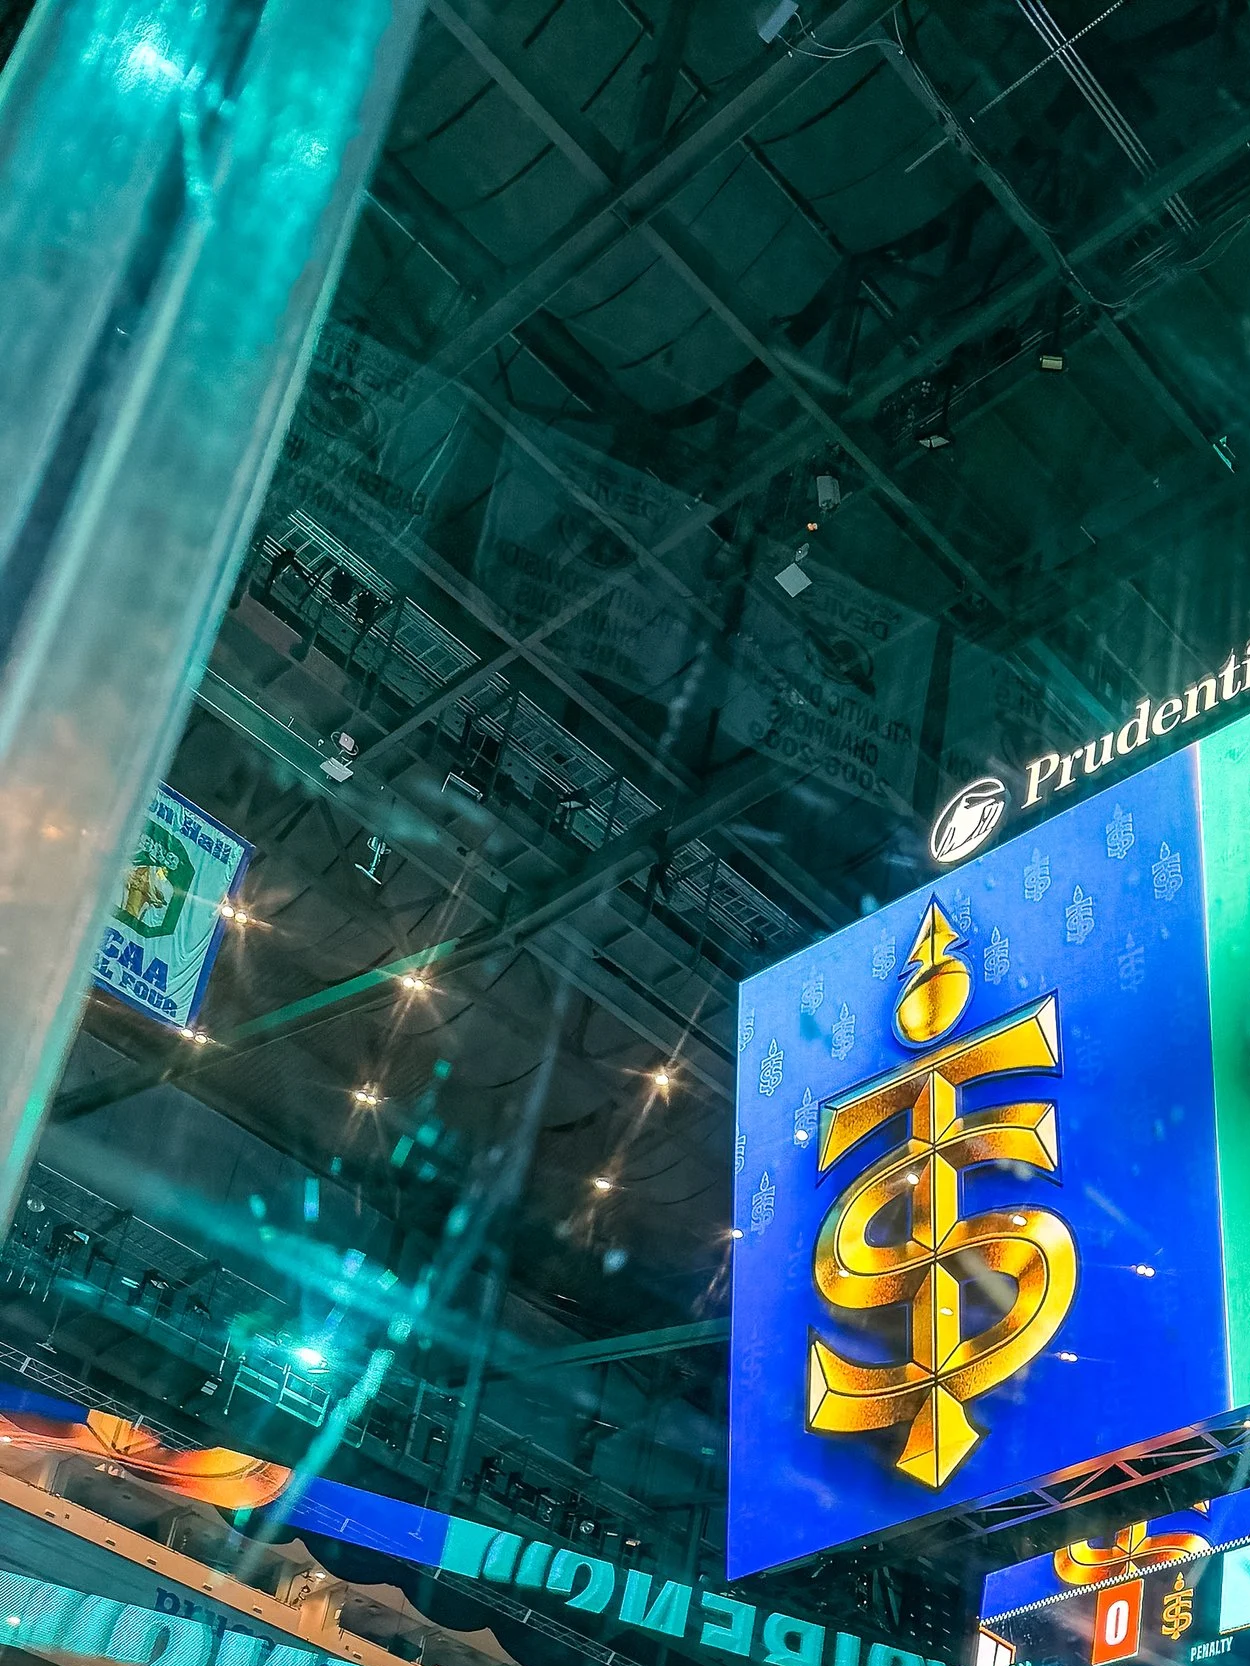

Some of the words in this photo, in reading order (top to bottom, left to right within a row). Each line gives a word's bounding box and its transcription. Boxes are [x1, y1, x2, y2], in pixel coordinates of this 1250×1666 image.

[103, 926, 170, 993] CAA
[121, 974, 178, 1017] FOUR
[1103, 1599, 1131, 1647] 0
[1189, 1637, 1234, 1663] PENALTY
